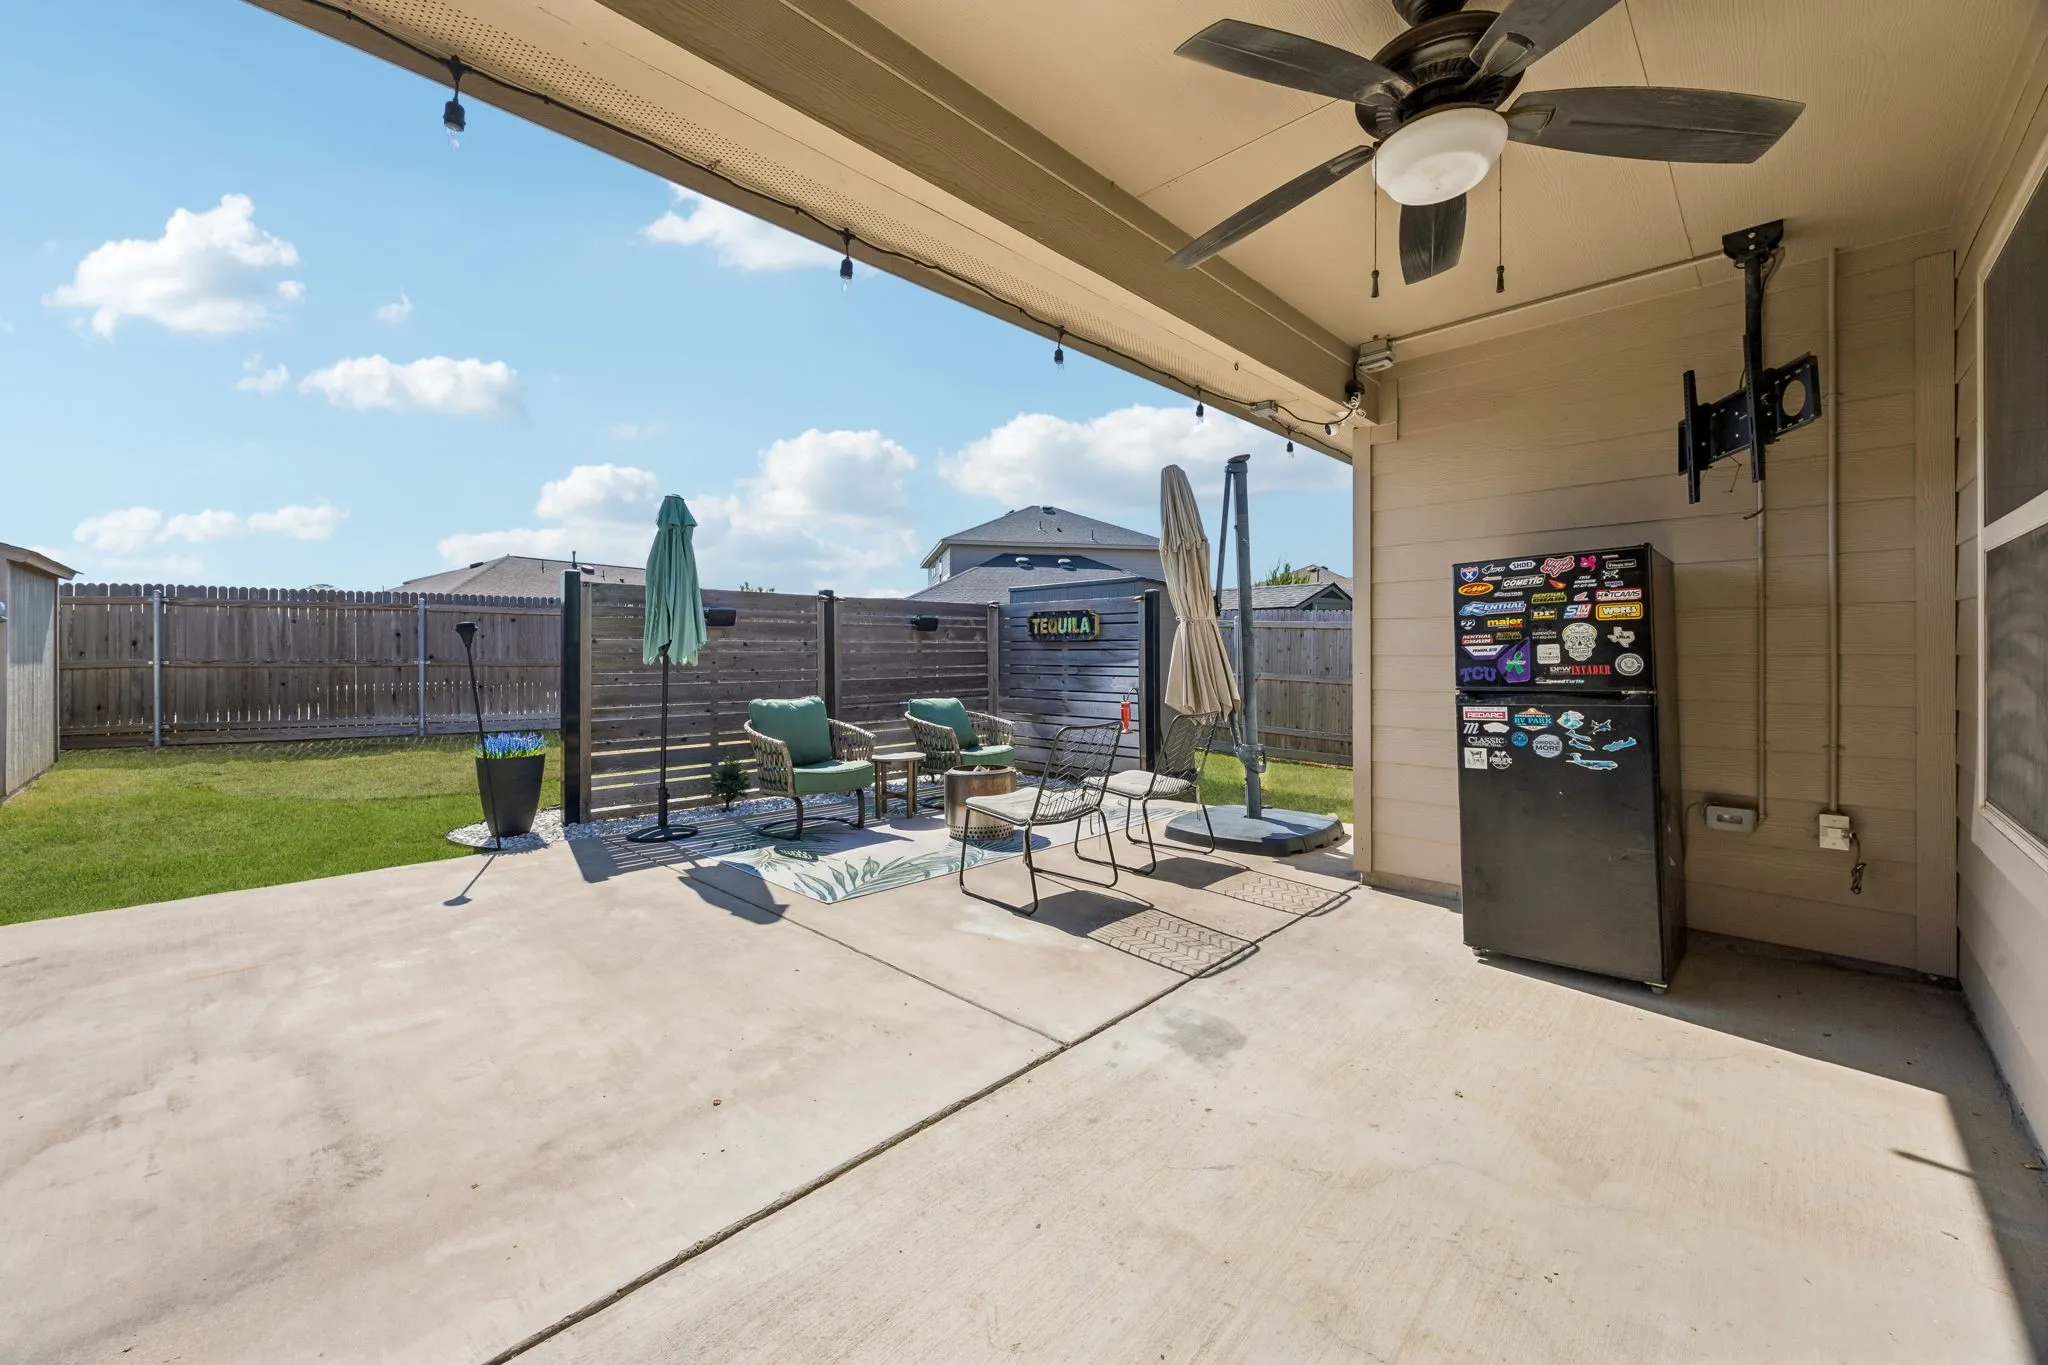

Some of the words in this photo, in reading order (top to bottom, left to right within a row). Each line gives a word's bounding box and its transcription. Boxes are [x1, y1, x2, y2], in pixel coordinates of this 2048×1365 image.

[1512, 561, 1533, 569] SHOEI
[1503, 575, 1543, 587] COMETIC
[1031, 616, 1090, 634] TEQUILA
[1487, 617, 1522, 626] maier
[1461, 666, 1496, 682] TCU
[1571, 665, 1612, 675] INVADER
[1467, 736, 1505, 744] CLASSIC
